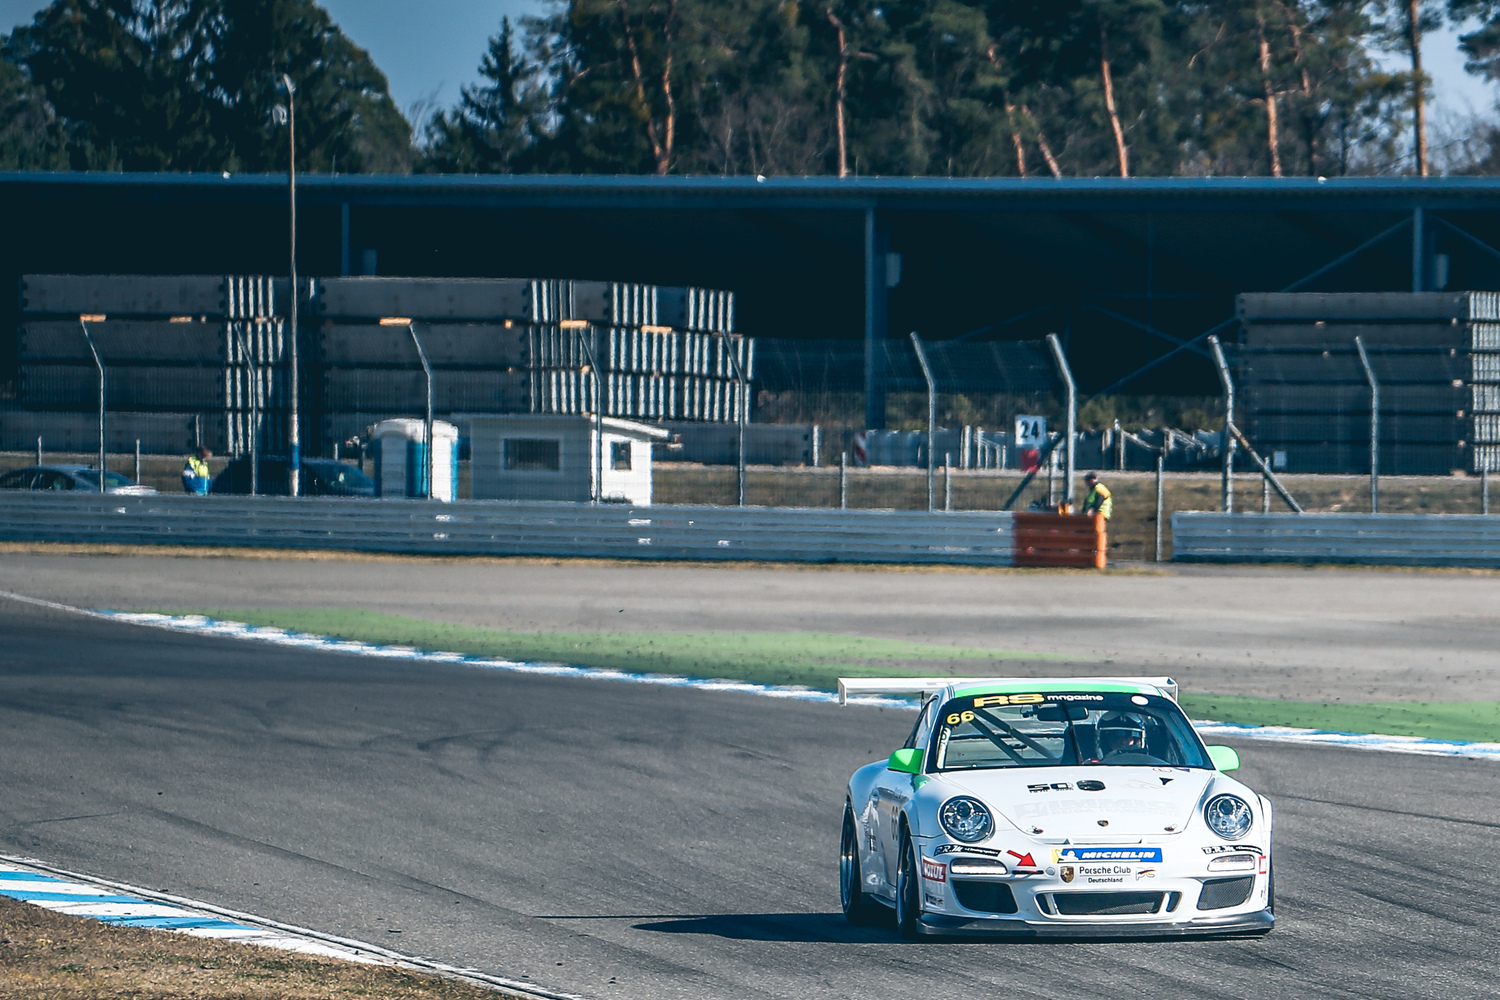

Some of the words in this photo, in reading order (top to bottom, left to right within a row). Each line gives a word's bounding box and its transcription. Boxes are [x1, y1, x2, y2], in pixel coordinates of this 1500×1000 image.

[1020, 419, 1039, 438] 24
[973, 693, 1045, 708] RS
[1047, 693, 1104, 702] magazine
[946, 710, 975, 725] 66
[1081, 851, 1156, 859] MICHELIN
[924, 863, 944, 880] MOTUL
[1079, 866, 1112, 875] Porsche
[1113, 865, 1132, 874] Club
